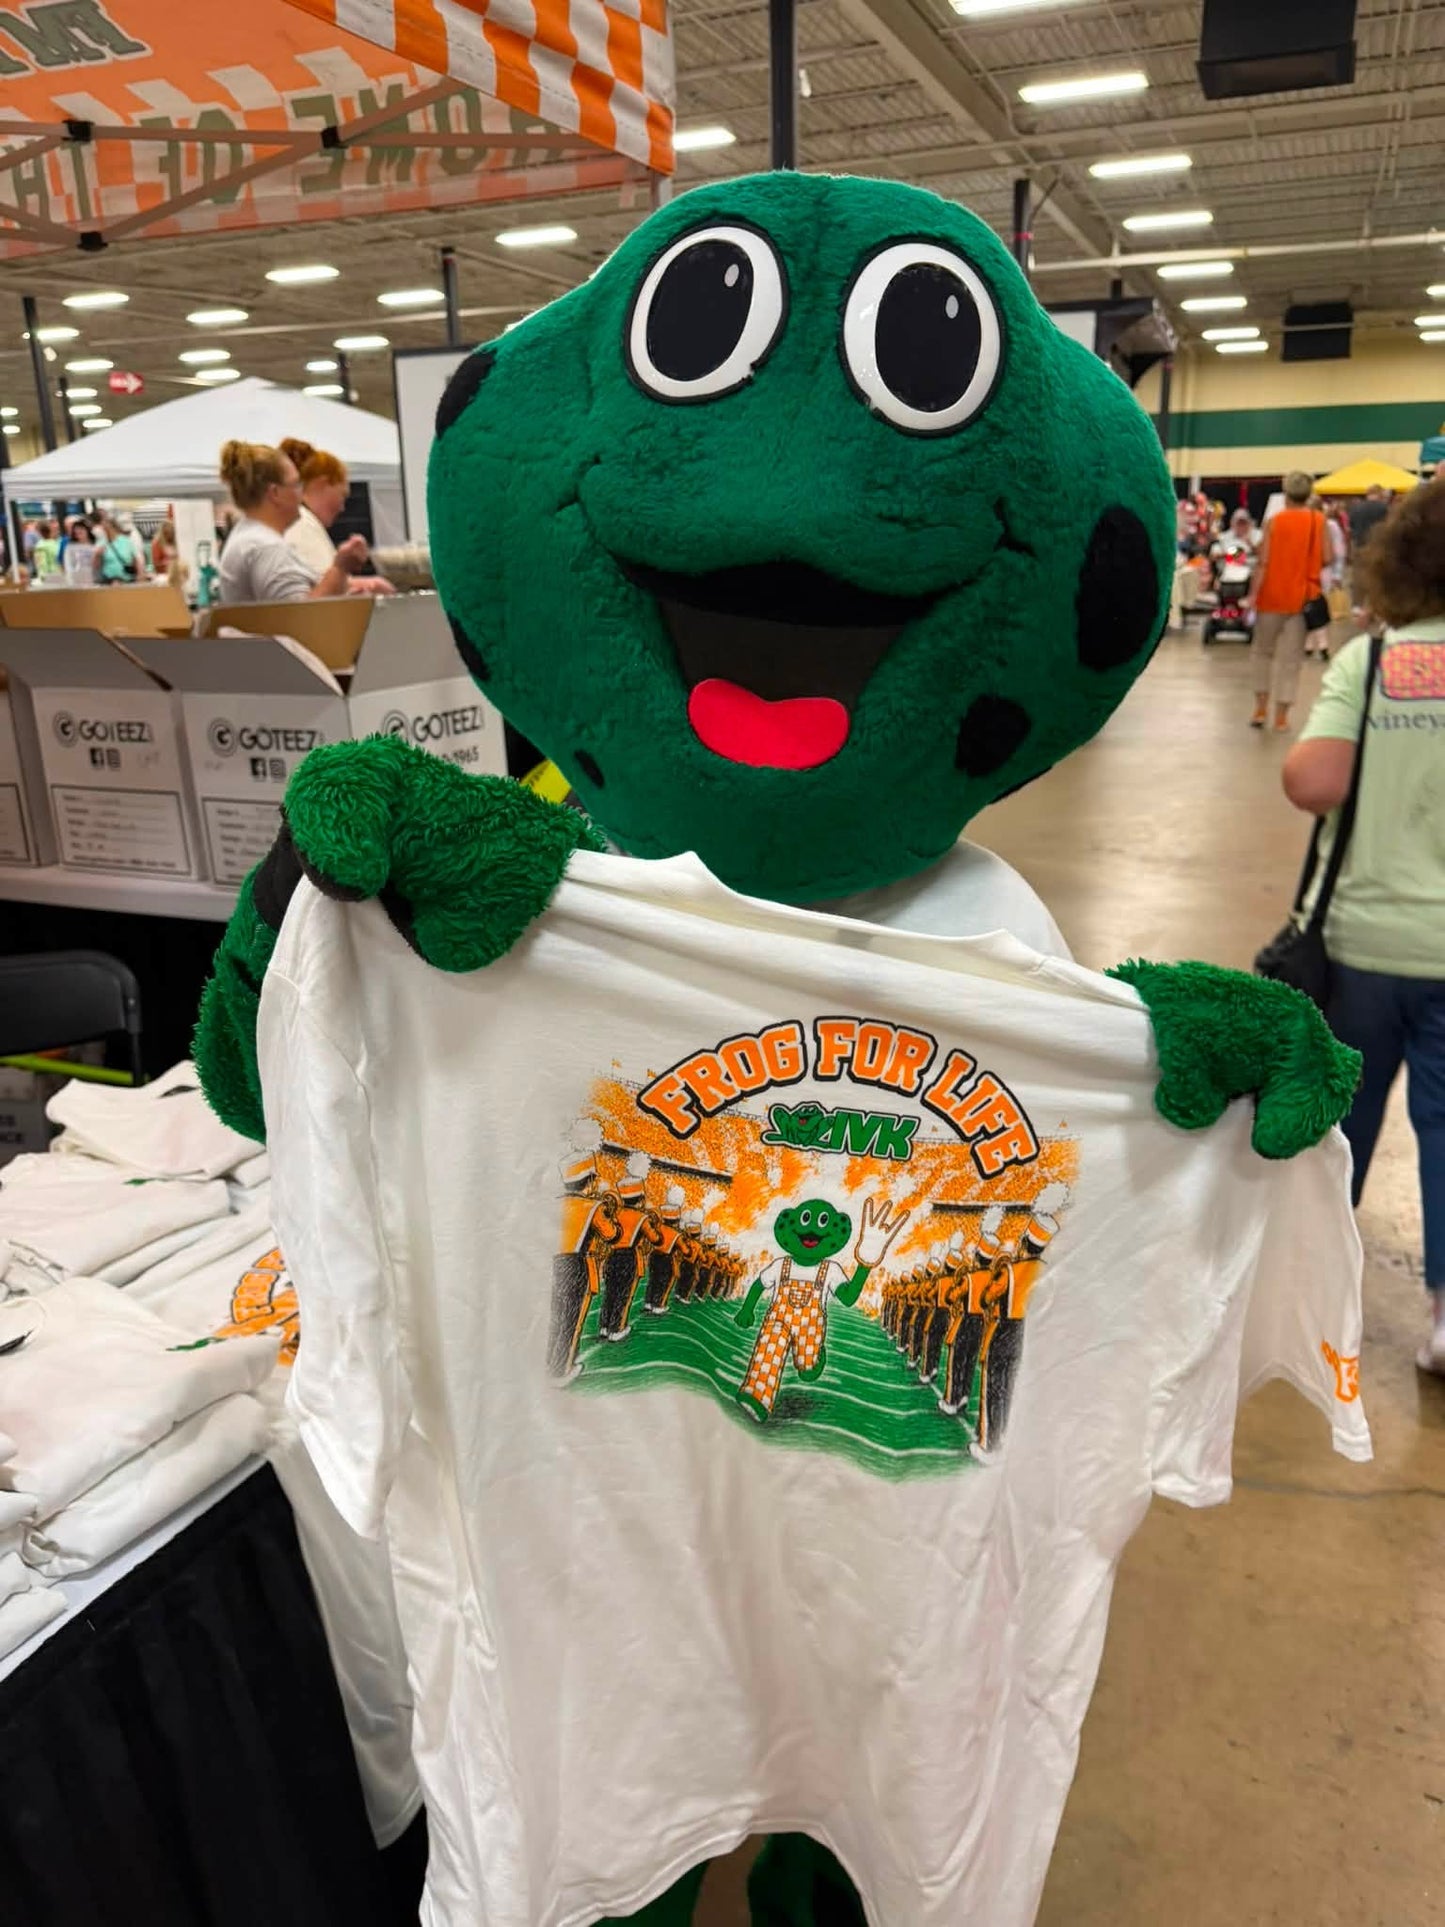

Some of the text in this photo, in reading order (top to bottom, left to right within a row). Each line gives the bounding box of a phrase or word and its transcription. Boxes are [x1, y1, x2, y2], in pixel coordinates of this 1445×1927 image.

[412, 705, 482, 743] GOTEEZ
[637, 1016, 1040, 1180] FROG FOR LIFE
